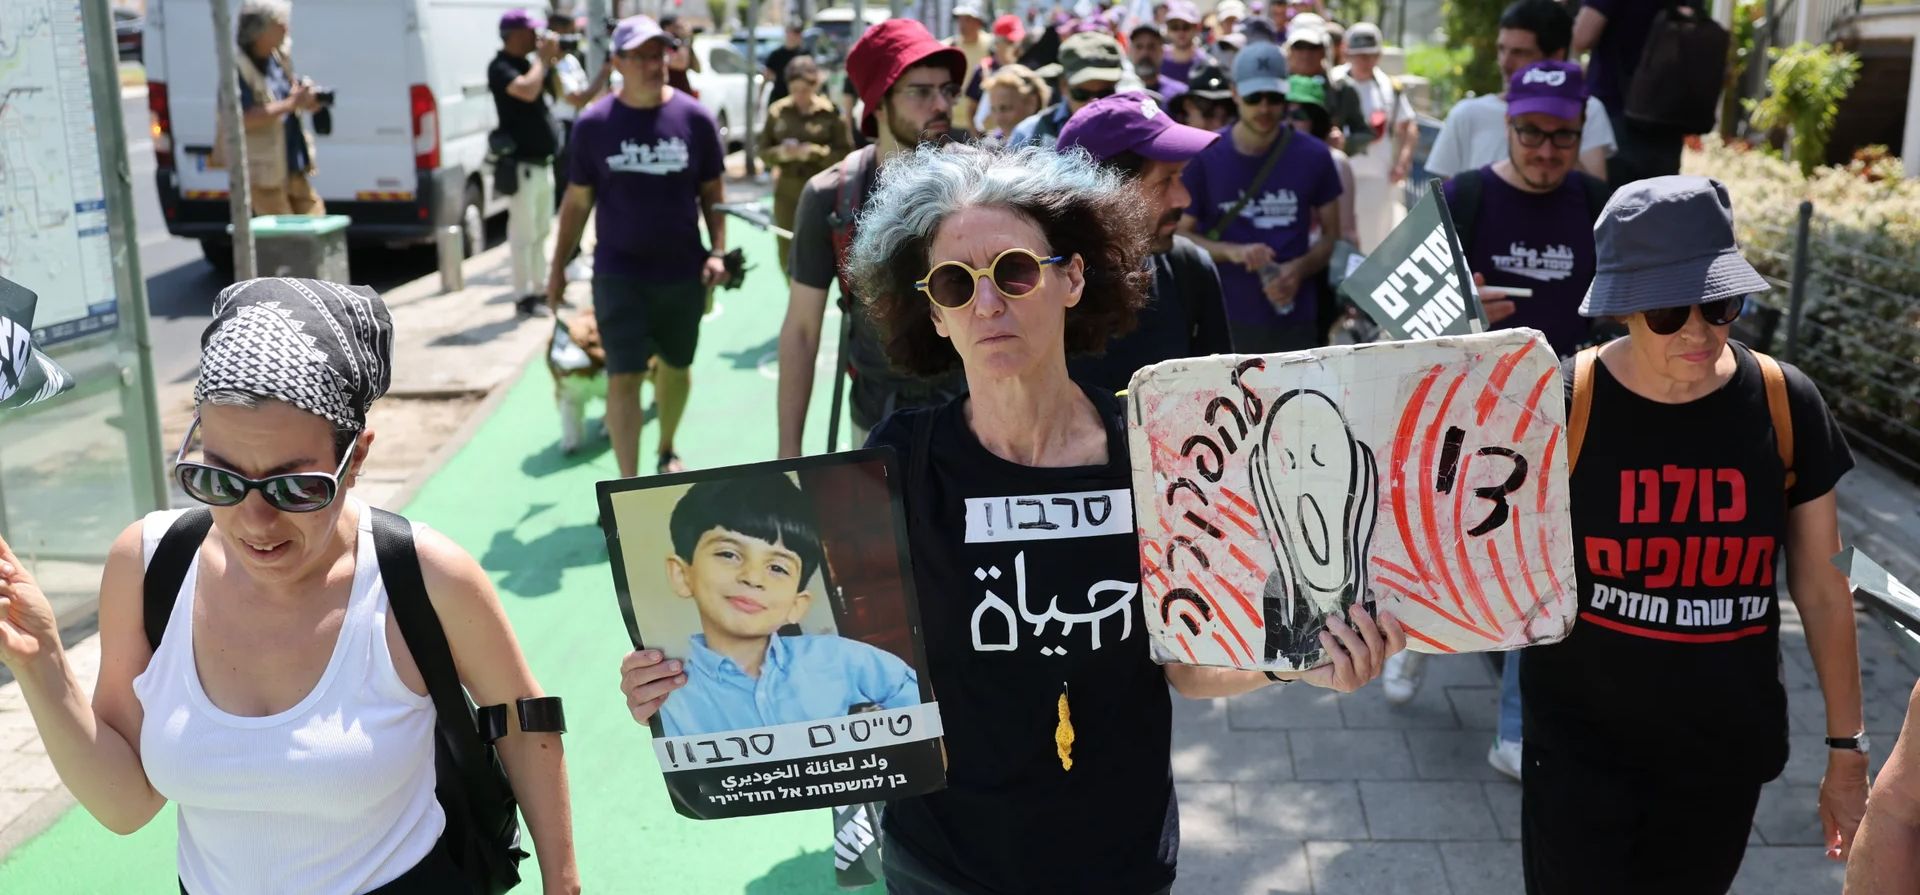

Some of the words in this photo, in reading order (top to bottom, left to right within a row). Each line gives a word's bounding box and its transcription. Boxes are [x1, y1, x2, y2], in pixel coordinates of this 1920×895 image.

[1370, 222, 1454, 320] סרבים
[1619, 465, 1747, 523] כולנו
[984, 495, 1112, 536] סרבו!
[1585, 536, 1775, 588] חטופים
[1590, 583, 1669, 623] חוזרים
[1676, 598, 1733, 626] שהם
[1739, 595, 1770, 621] עד
[665, 733, 775, 768] סרבו!
[860, 753, 888, 771] ولد
[721, 764, 799, 790] الخوديري
[805, 758, 855, 777] لعائلة
[887, 773, 907, 788] בן
[778, 785, 802, 799] אל
[807, 775, 883, 797] למשפחת
